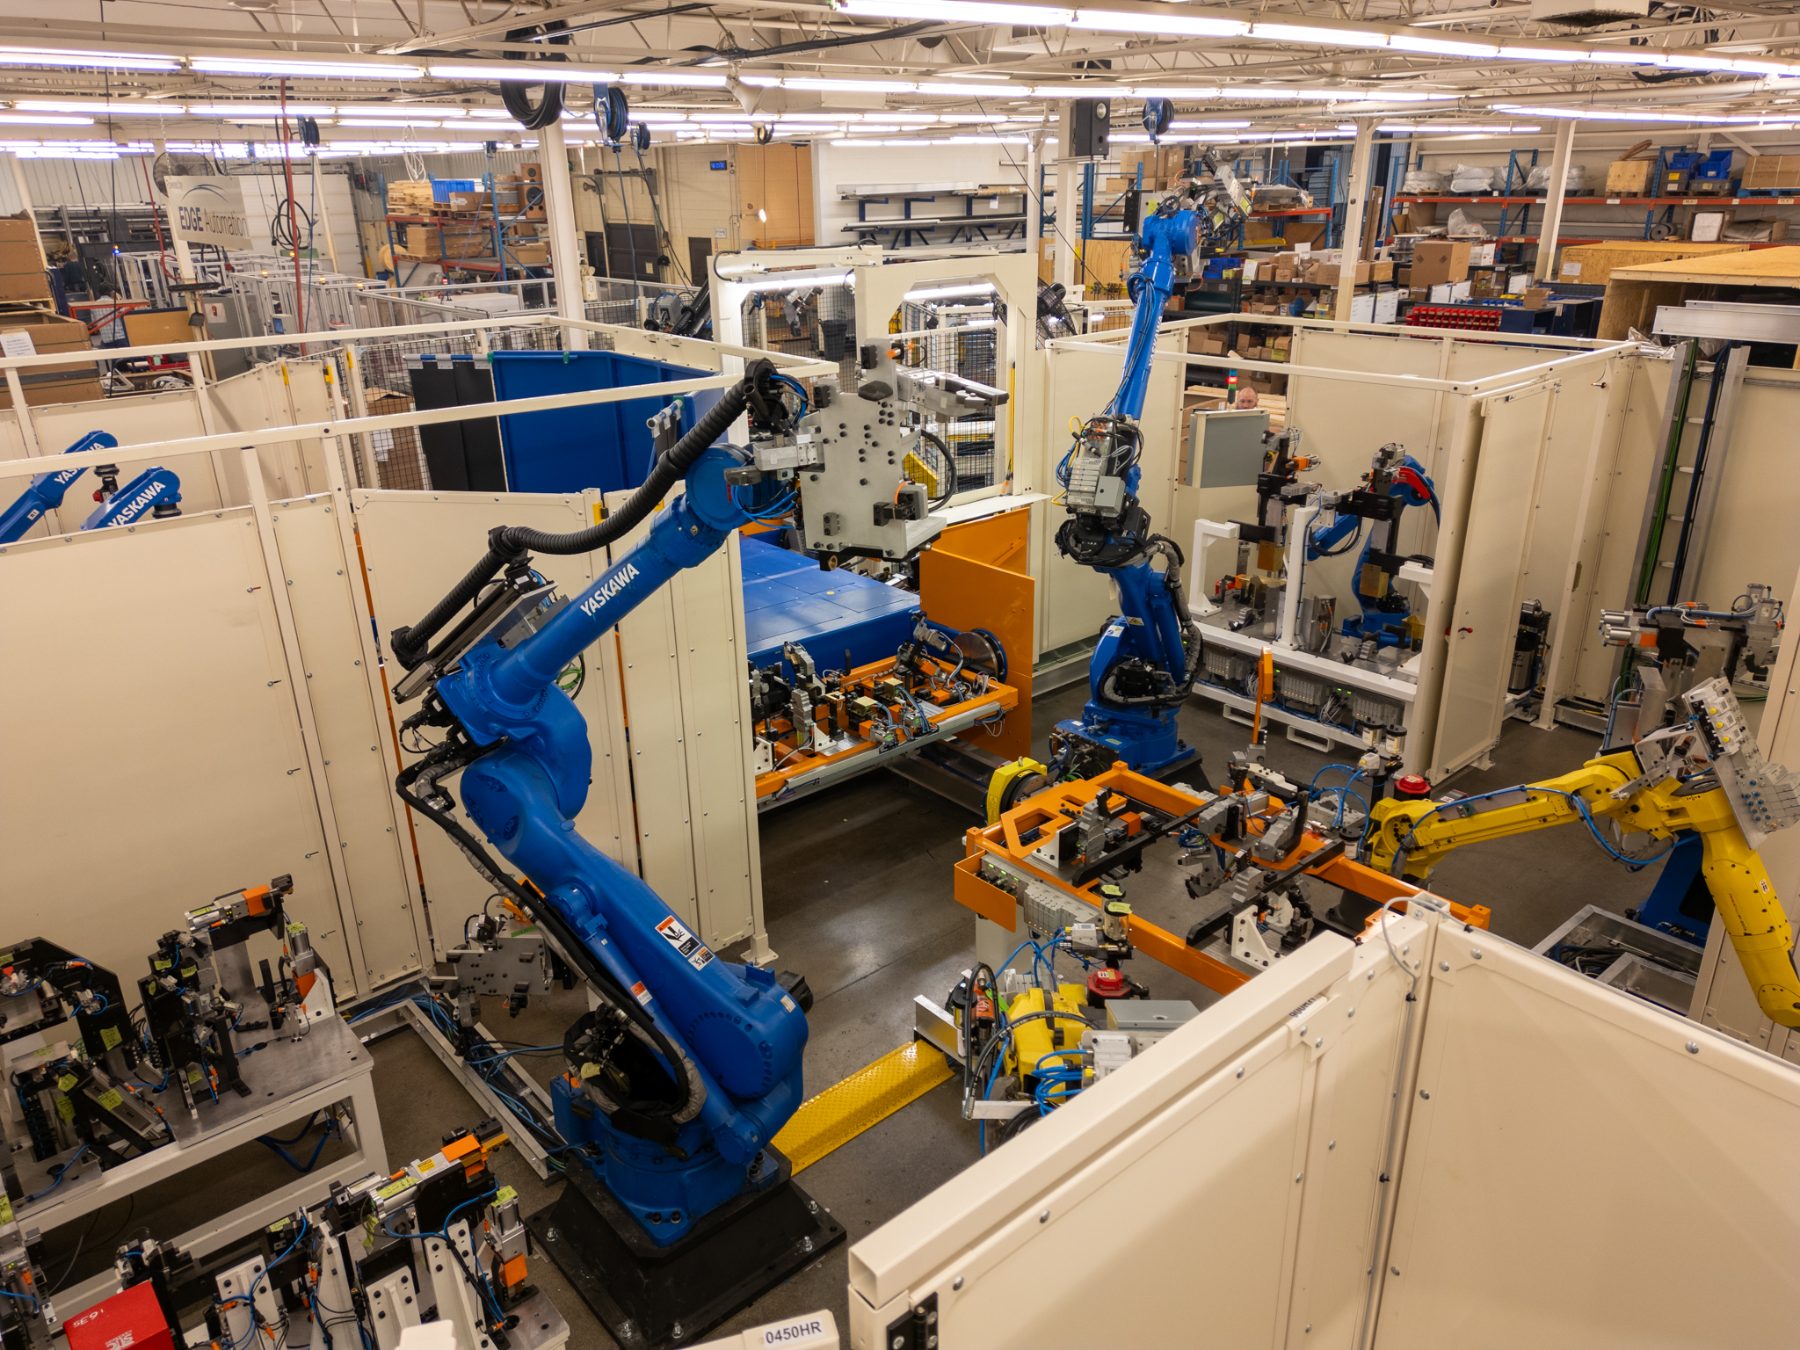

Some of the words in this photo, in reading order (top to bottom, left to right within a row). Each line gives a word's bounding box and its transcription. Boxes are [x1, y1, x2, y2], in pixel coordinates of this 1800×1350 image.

[178, 206, 204, 232] EDGE
[204, 208, 250, 238] Automation
[580, 563, 640, 616] YASKAWA
[765, 1321, 822, 1344] 0450HR
